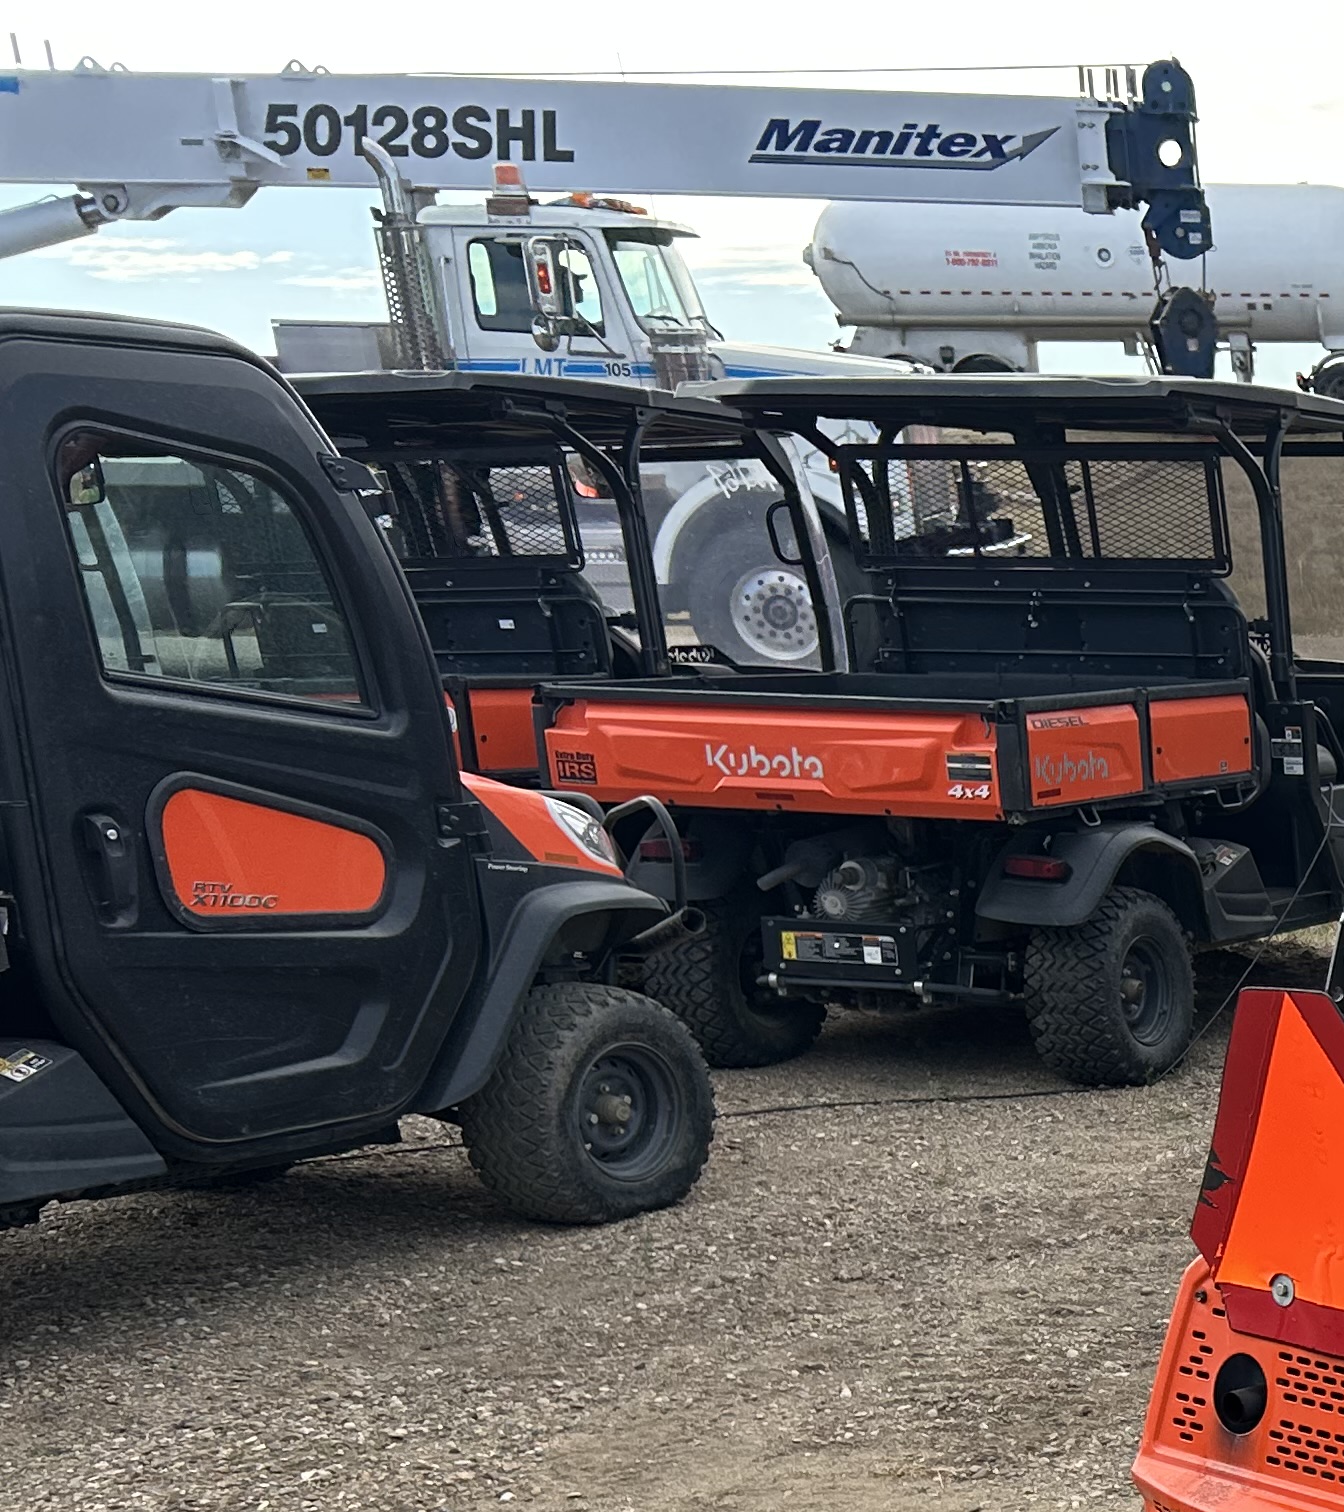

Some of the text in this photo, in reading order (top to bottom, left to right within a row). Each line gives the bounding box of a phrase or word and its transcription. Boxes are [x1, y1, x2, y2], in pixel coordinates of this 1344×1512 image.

[263, 104, 575, 162] 50128SHL
[755, 118, 1018, 160] Manitex
[522, 358, 631, 377] LMT 105
[1031, 716, 1090, 729] DIESEL
[558, 761, 596, 779] IRS
[705, 744, 824, 779] Kubota
[1034, 750, 1109, 785] Kubota
[947, 784, 990, 799] 4x4
[192, 881, 233, 893] RTV
[190, 893, 279, 910] X1100C
